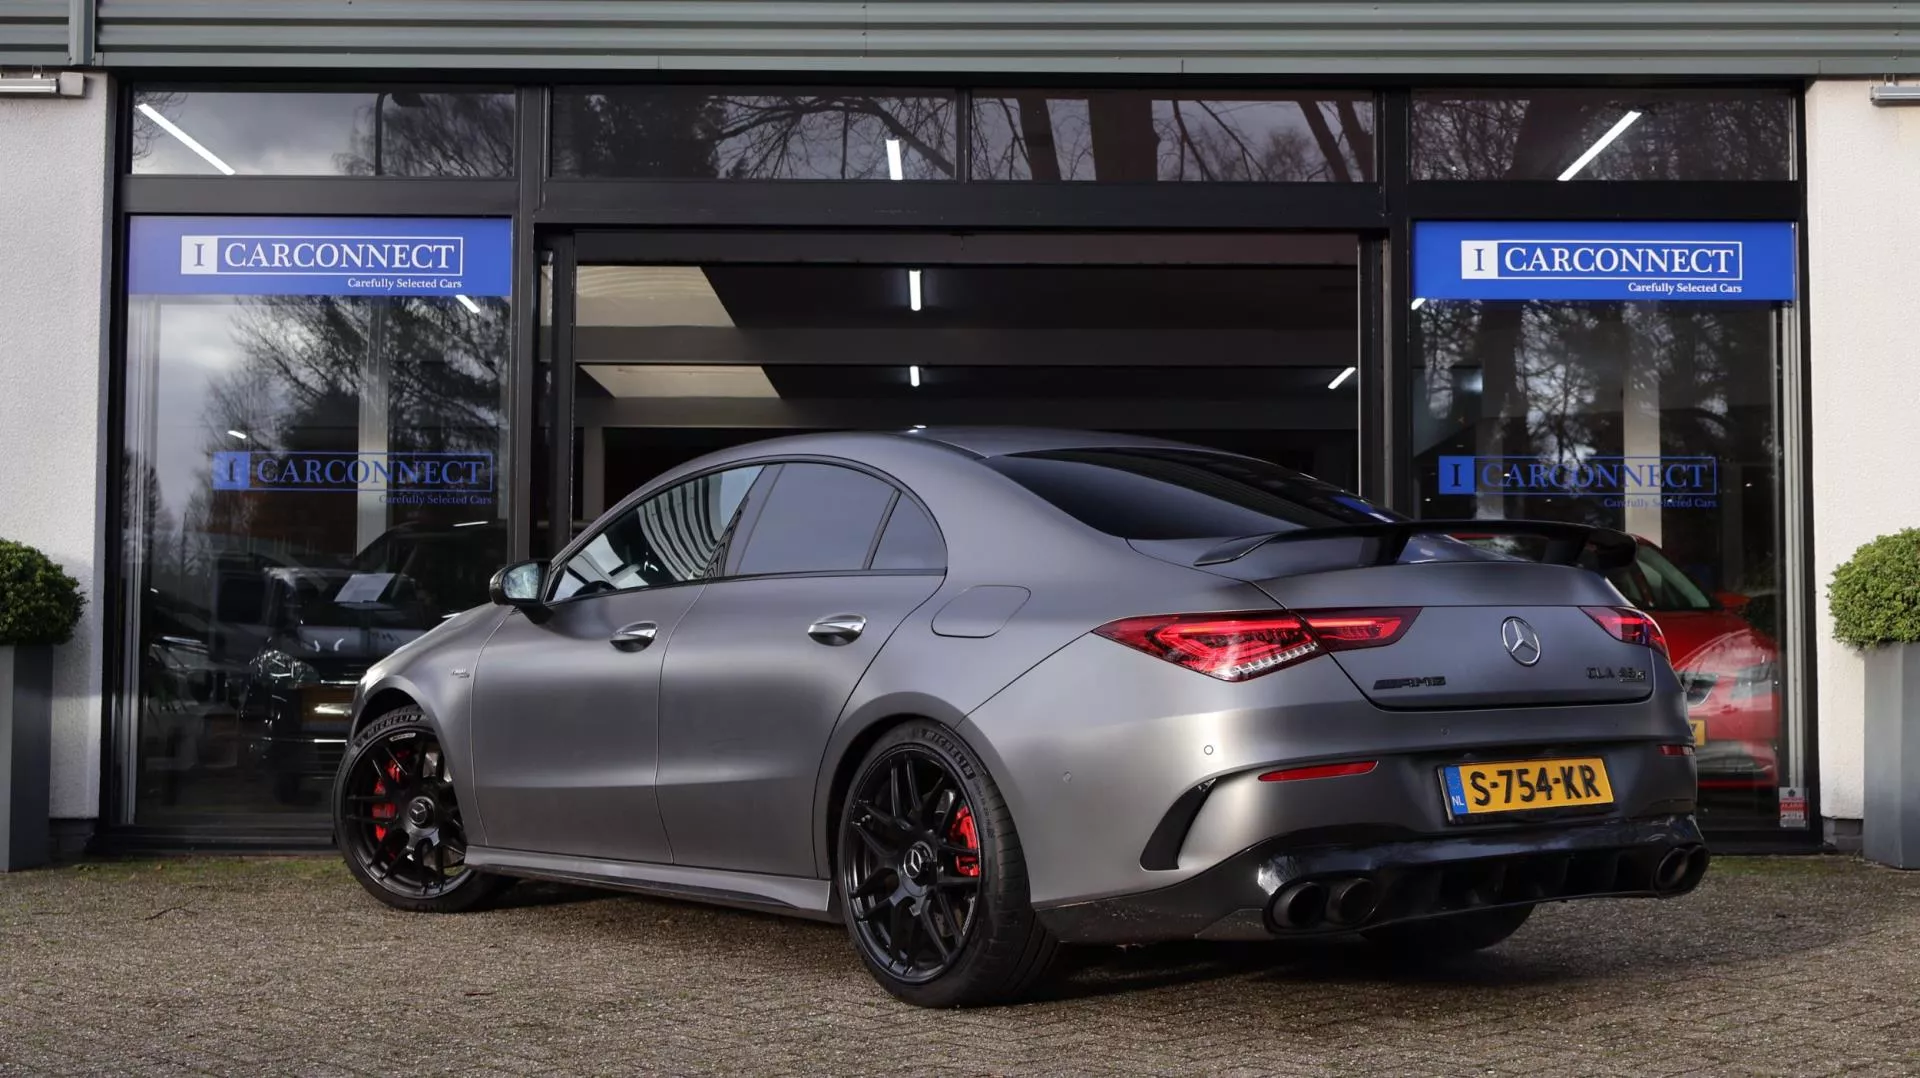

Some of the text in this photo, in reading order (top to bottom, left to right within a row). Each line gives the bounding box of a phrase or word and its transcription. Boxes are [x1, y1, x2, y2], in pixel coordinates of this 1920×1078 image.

[194, 242, 455, 269] I CARCONNECT
[1473, 247, 1734, 273] I CARCONNECT
[347, 278, 462, 290] Carefully Selected Cars
[1628, 282, 1742, 295] Carefully Selected Cars
[257, 458, 485, 485] CARCONNECT
[1481, 463, 1708, 488] CARCONNECT
[378, 494, 492, 506] Carefully Selected Cars
[925, 730, 974, 778] MICHELIN
[1451, 765, 1601, 807] NL S-754-KR
